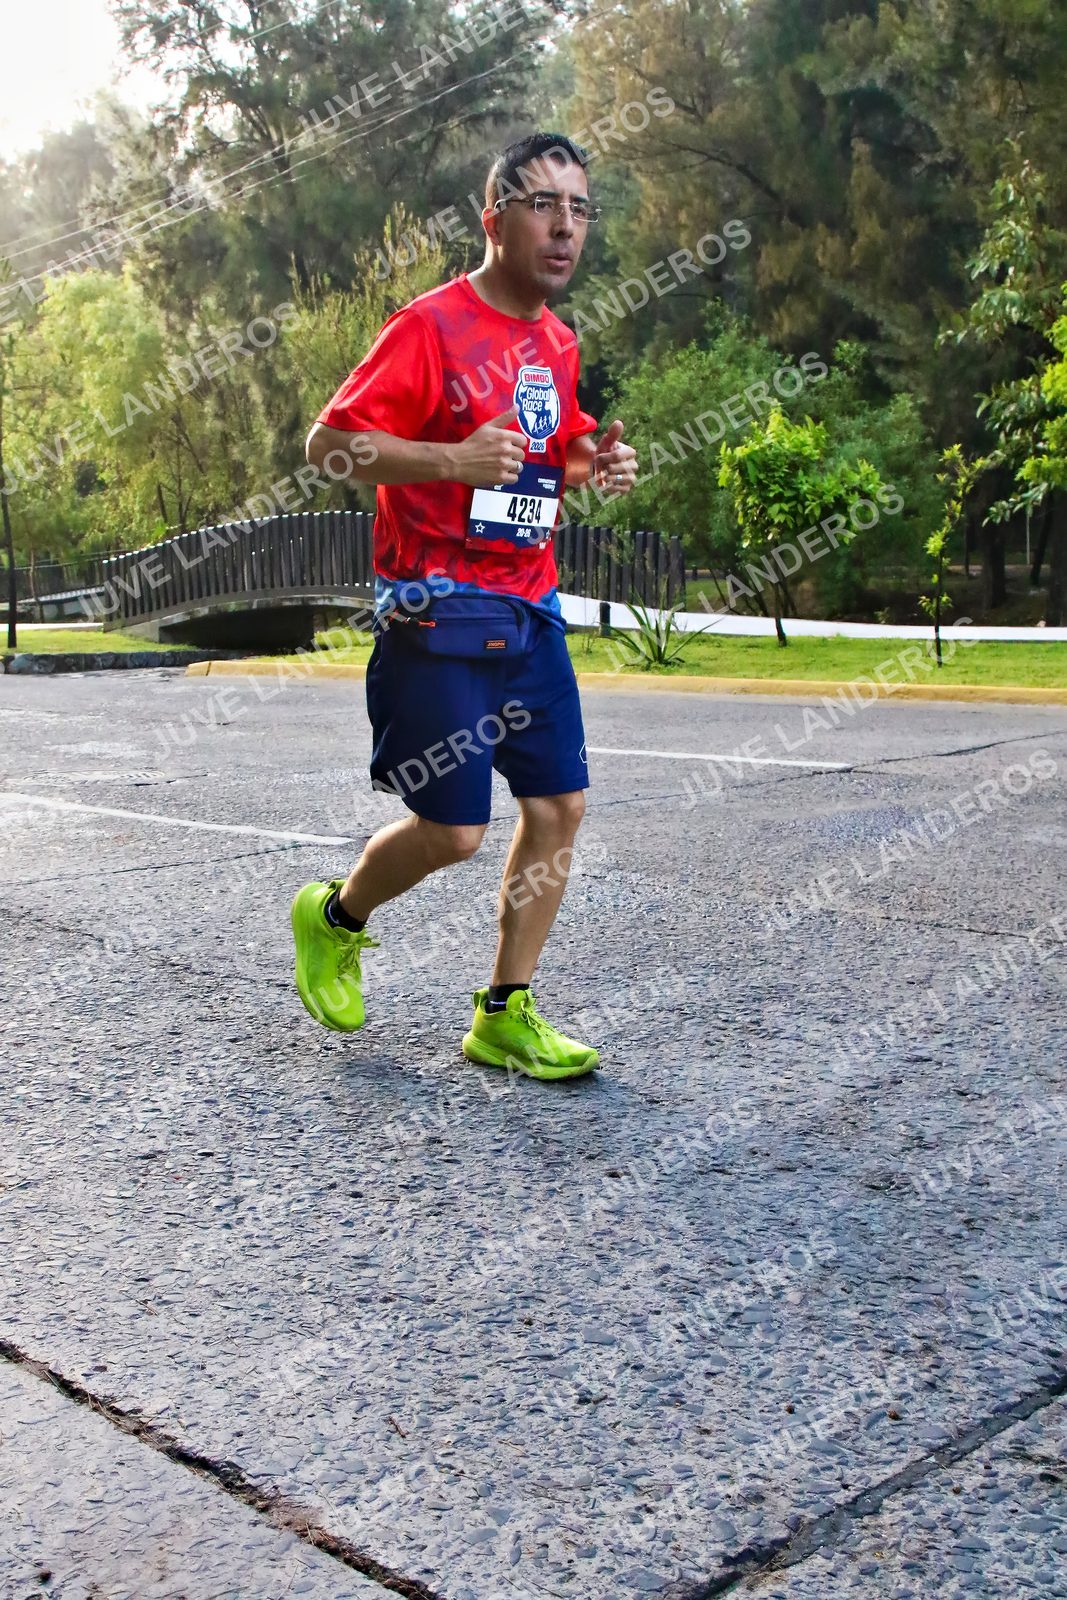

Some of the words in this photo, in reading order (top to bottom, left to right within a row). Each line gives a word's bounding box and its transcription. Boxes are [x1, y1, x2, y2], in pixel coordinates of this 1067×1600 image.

[524, 373, 549, 383] BIMBO
[527, 388, 550, 400] Global
[523, 400, 543, 411] Race
[530, 441, 545, 451] 2026
[507, 496, 542, 524] 4234
